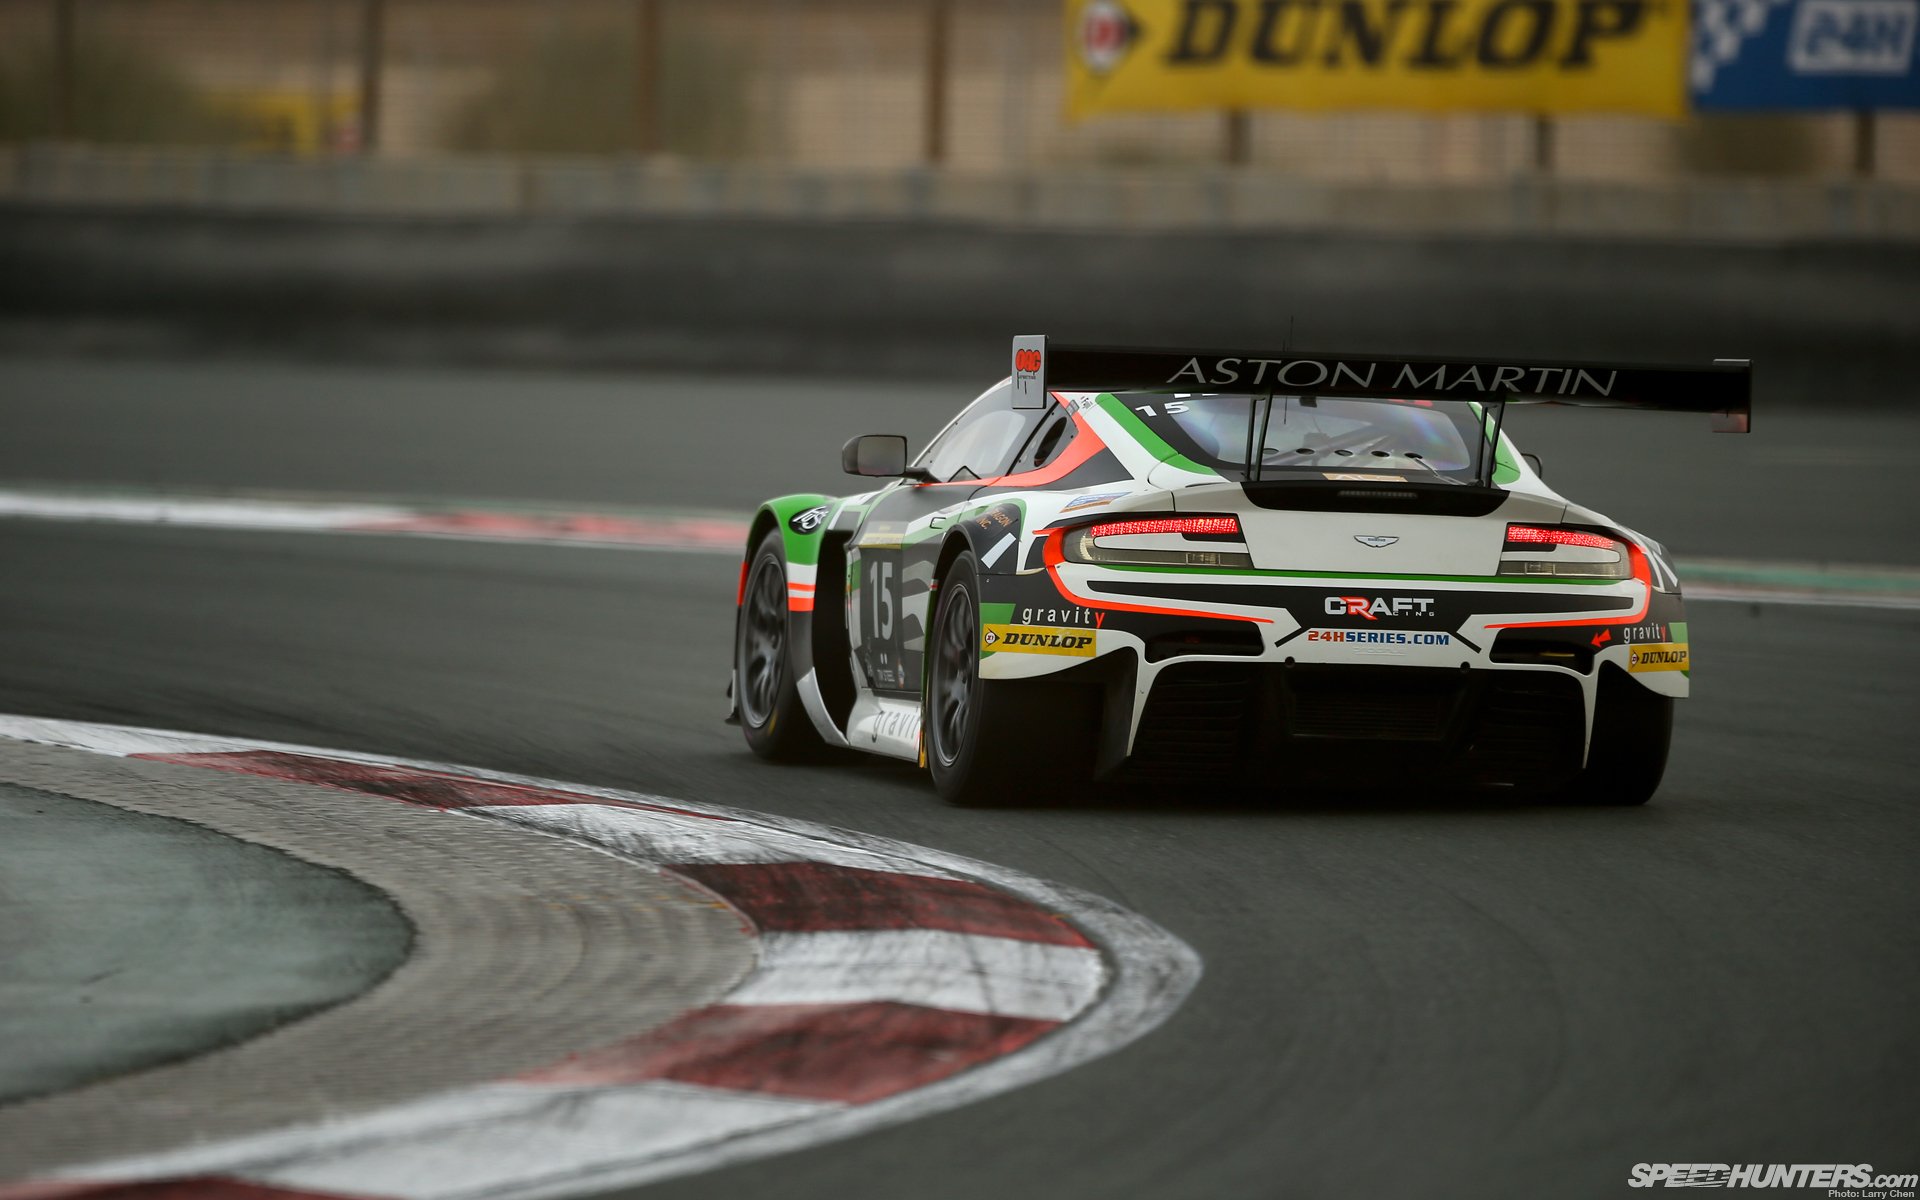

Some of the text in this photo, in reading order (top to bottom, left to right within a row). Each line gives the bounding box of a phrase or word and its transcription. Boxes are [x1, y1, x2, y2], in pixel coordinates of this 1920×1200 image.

[1166, 0, 1648, 70] DUNLOP
[1166, 356, 1618, 397] ASTON MARTIN
[1135, 401, 1190, 417] 15
[869, 561, 894, 641] 15
[1324, 596, 1435, 620] CRAFT
[1021, 606, 1106, 630] gravity
[1002, 632, 1093, 650] DUNLOP
[1307, 631, 1449, 645] 24HSERIES.COM
[1623, 622, 1666, 644] gravity
[1640, 651, 1687, 664] DUNLOP
